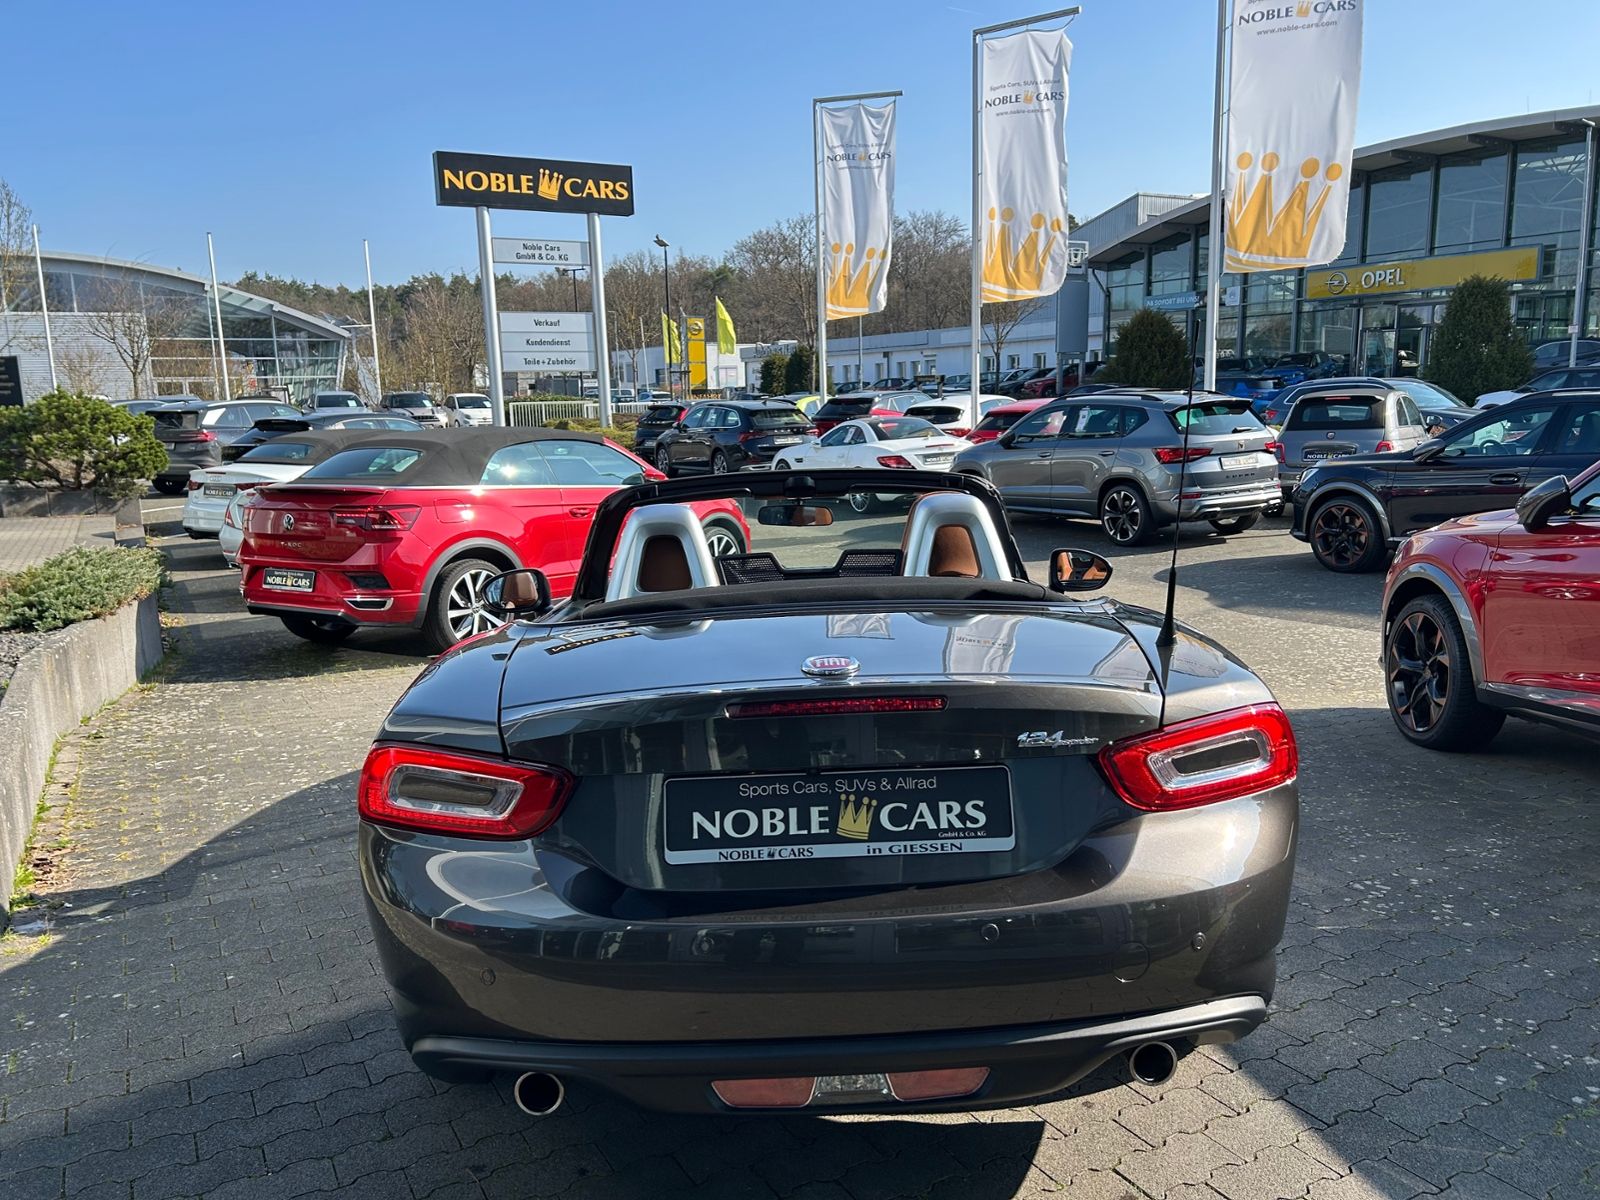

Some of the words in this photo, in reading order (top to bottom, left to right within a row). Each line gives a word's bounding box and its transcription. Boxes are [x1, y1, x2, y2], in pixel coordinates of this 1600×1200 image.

[1238, 6, 1294, 26] NOBLE
[1313, 0, 1357, 14] CARS
[1256, 19, 1338, 36] www.noble-cars.com
[985, 93, 1022, 109] NOBLE
[1035, 91, 1065, 102] CARS
[826, 152, 857, 162] NOBLE
[868, 150, 892, 161] CARS
[443, 169, 534, 195] NOBLE
[563, 177, 630, 200] CARS
[522, 243, 543, 251] Noble
[544, 243, 561, 252] Cars
[515, 252, 536, 260] GmbH
[545, 253, 557, 261] Co.
[558, 253, 569, 262] KG
[1361, 267, 1405, 289] OPEL
[533, 319, 561, 327] Verkauf
[525, 338, 571, 346] Kundendienst
[266, 575, 287, 585] NOBLE
[292, 577, 310, 587] CARS
[814, 658, 847, 668] FIAT
[1016, 730, 1064, 749] 124
[739, 782, 790, 798] Sports
[793, 780, 832, 795] Cars,
[835, 778, 877, 793] SUVs
[880, 777, 893, 791] &
[895, 776, 937, 790] Allrad
[692, 805, 830, 840] NOBLE
[879, 800, 987, 832] CARS
[718, 848, 765, 861] NOBLE
[778, 847, 814, 859] CARS
[866, 845, 882, 855] in
[888, 842, 963, 854] GIESSEN
